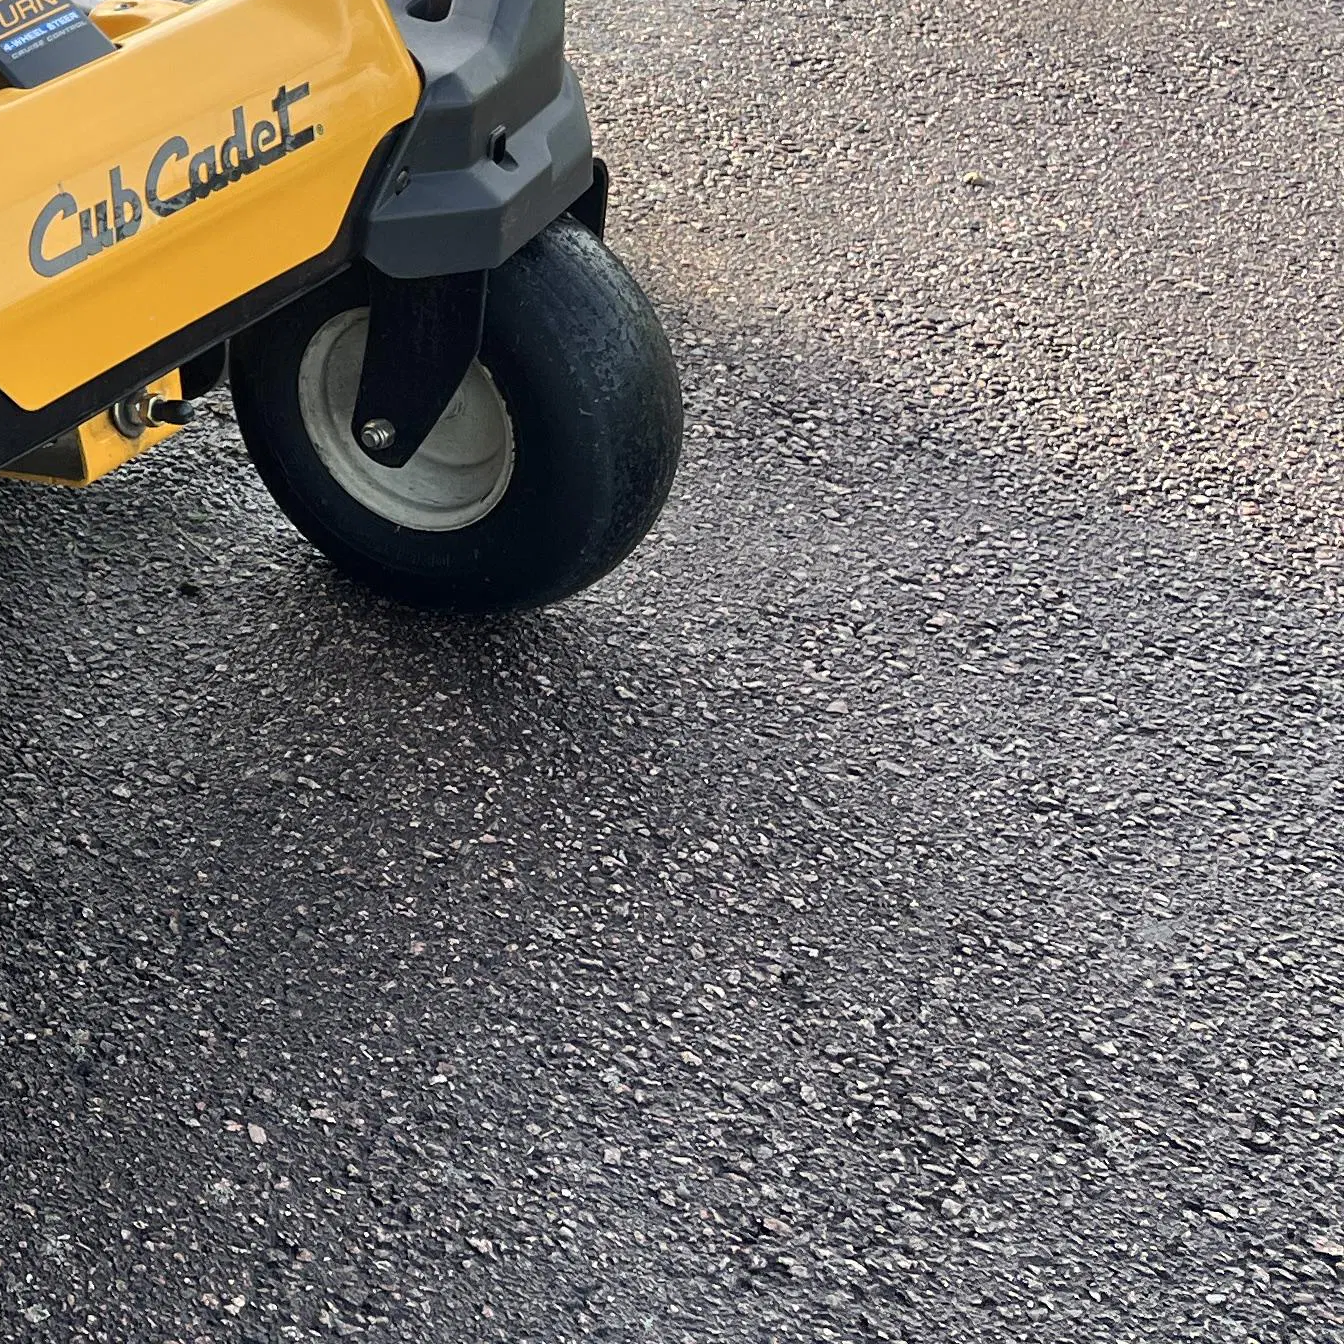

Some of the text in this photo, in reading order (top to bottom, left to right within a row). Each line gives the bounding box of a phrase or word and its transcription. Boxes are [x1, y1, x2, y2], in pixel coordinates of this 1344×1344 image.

[46, 11, 80, 31] STEER
[28, 82, 315, 278] Cub Cadet
